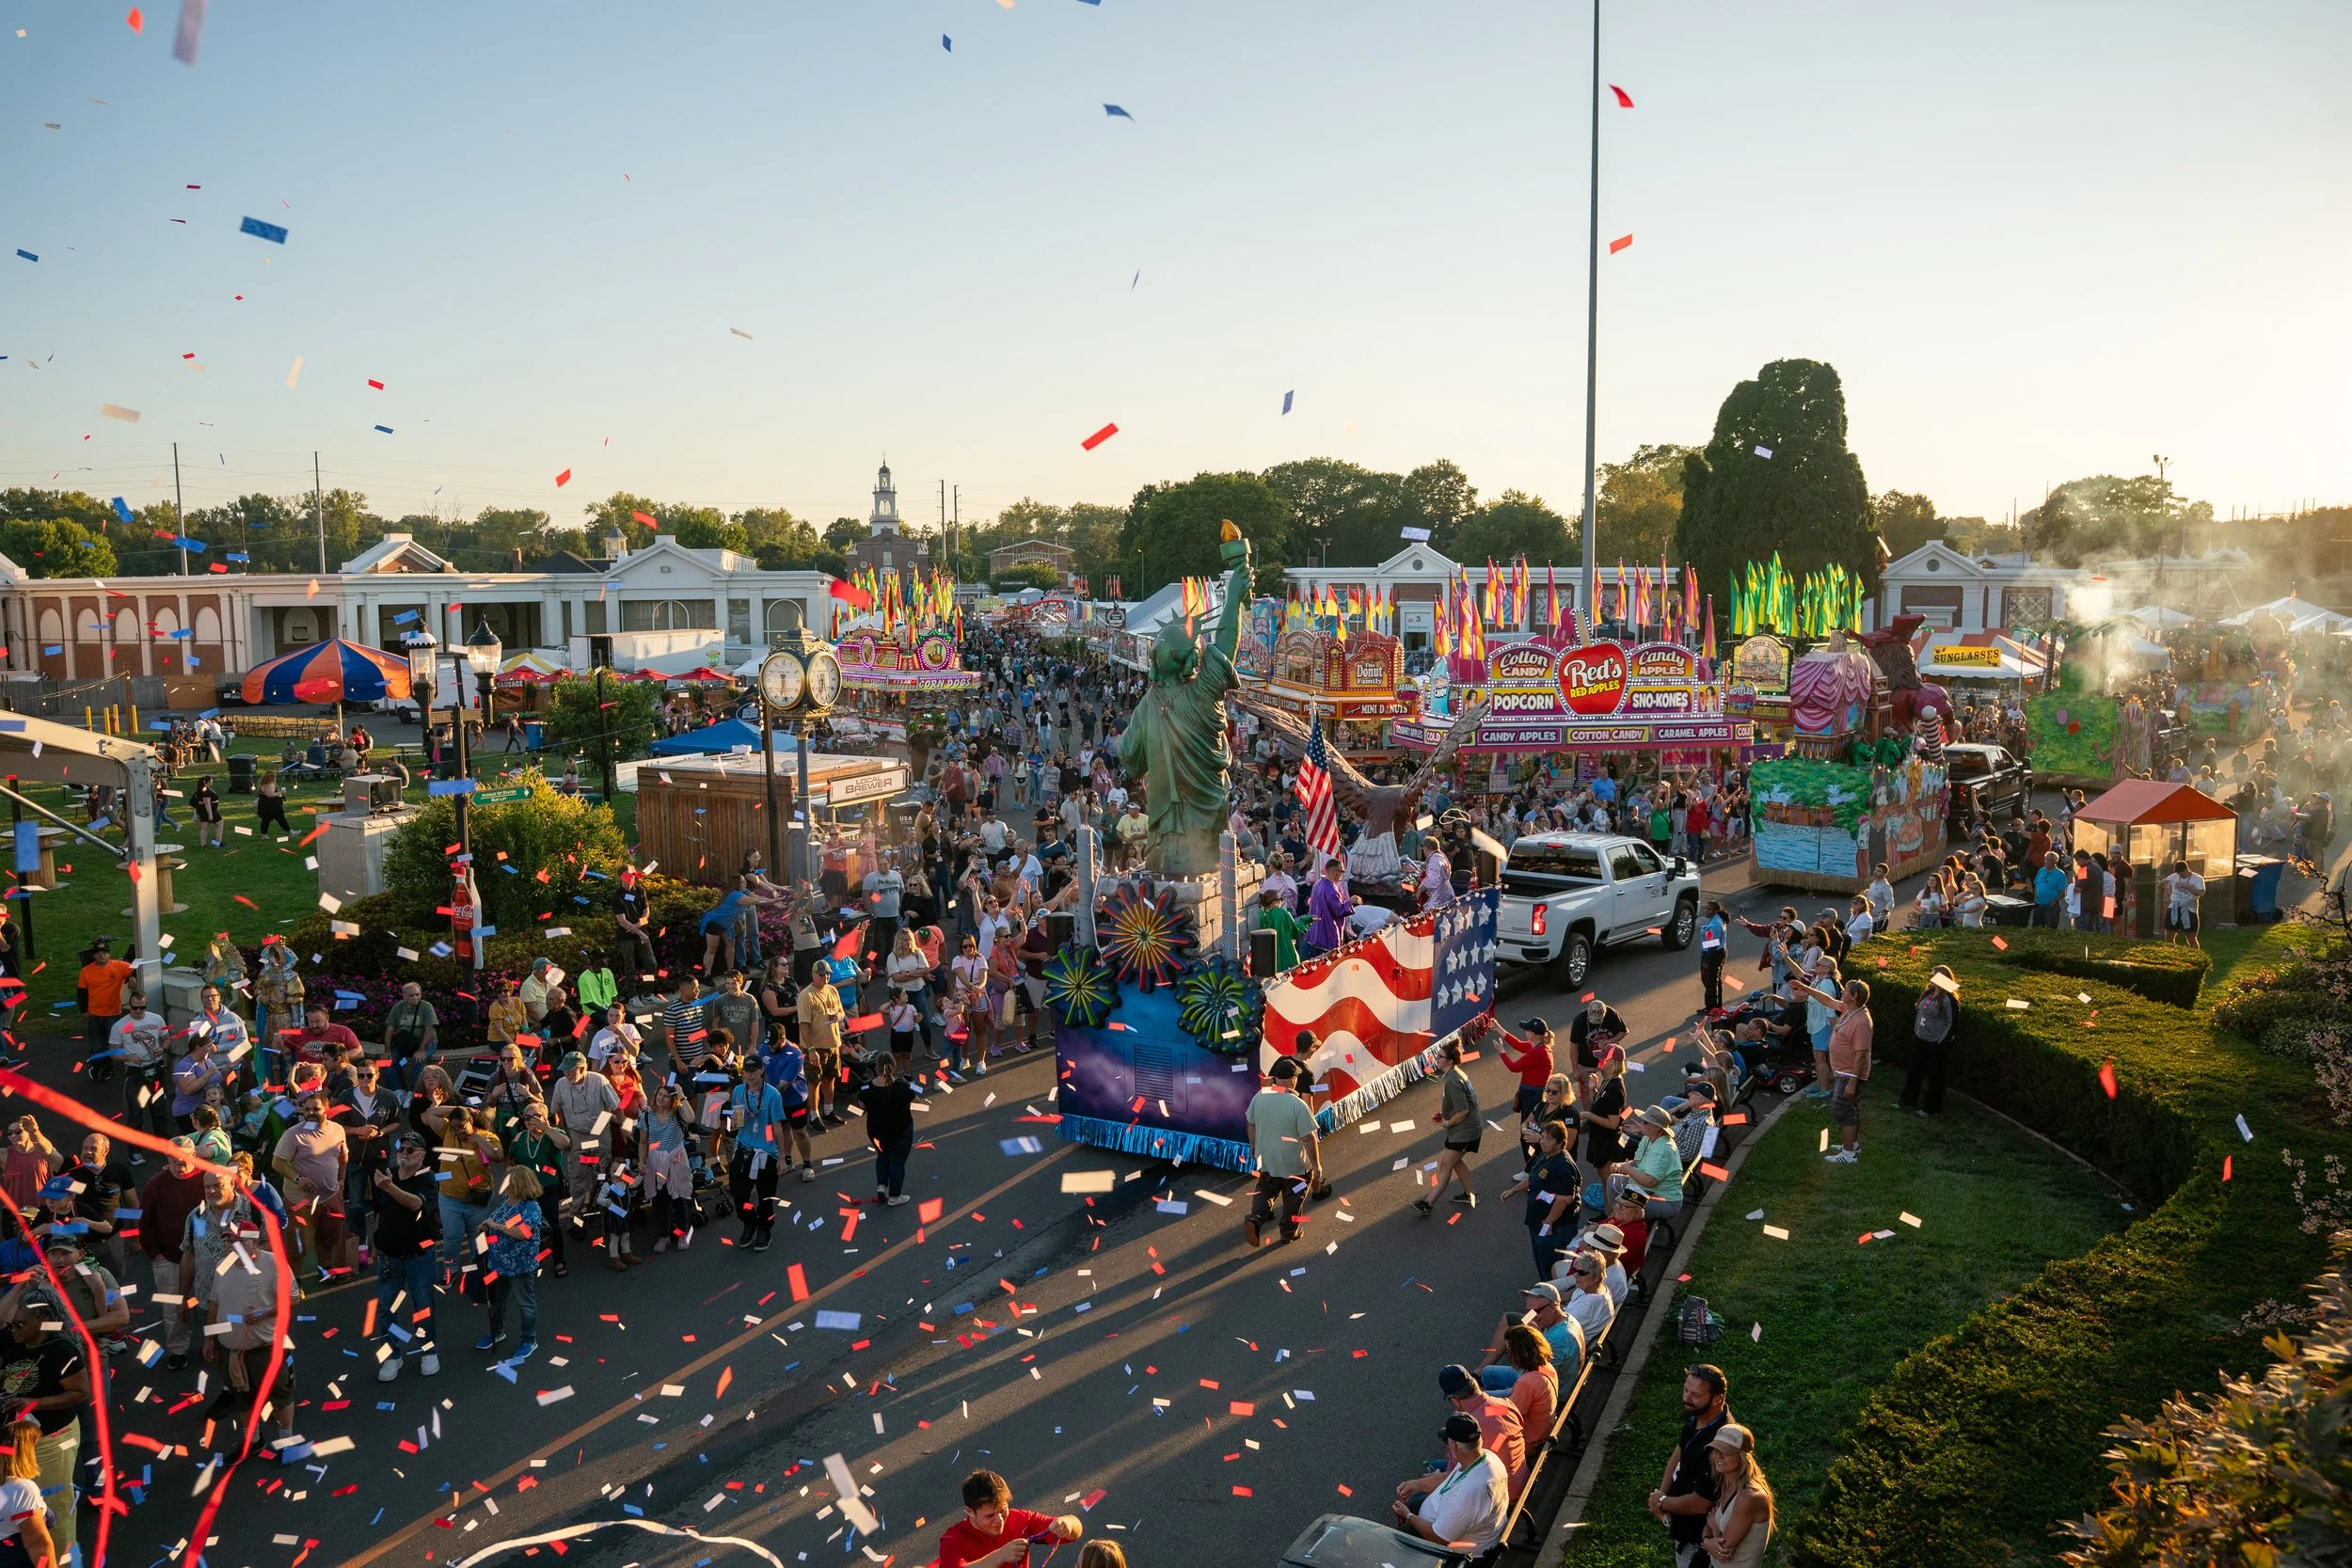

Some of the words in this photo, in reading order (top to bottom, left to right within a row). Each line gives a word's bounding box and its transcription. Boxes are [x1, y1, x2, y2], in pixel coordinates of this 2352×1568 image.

[1500, 651, 1549, 669] Cotton
[1639, 651, 1686, 667] Candy
[1933, 649, 1999, 663] SUNGLASSES
[1357, 664, 1383, 677] Donut
[1501, 665, 1547, 677] CANDY
[1564, 657, 1623, 688] Red's
[1639, 666, 1685, 675] APPLES
[497, 680, 524, 689] SAUSAGE
[919, 679, 944, 689] CORN
[946, 678, 971, 688] DOGS
[1395, 683, 1417, 691] CARAMEL
[1397, 690, 1418, 700] CORN
[1570, 686, 1588, 699] RED
[1588, 680, 1621, 696] APPLES
[1728, 687, 1754, 695] BOTTLED
[1494, 693, 1554, 710] POPCORN
[1632, 692, 1689, 708] SNO-KONES
[1361, 705, 1377, 714] MINI
[1426, 731, 1441, 741] COLD
[1483, 731, 1516, 742] CANDY
[1519, 731, 1557, 741] APPLES
[1571, 730, 1610, 740] COTTON
[1612, 729, 1645, 740] CANDY
[1659, 728, 1696, 738] CARAMEL
[1698, 727, 1728, 737] APPLES
[856, 776, 882, 784] LOCAL
[845, 778, 893, 794] BREWER
[854, 787, 882, 796] SHOWCASE
